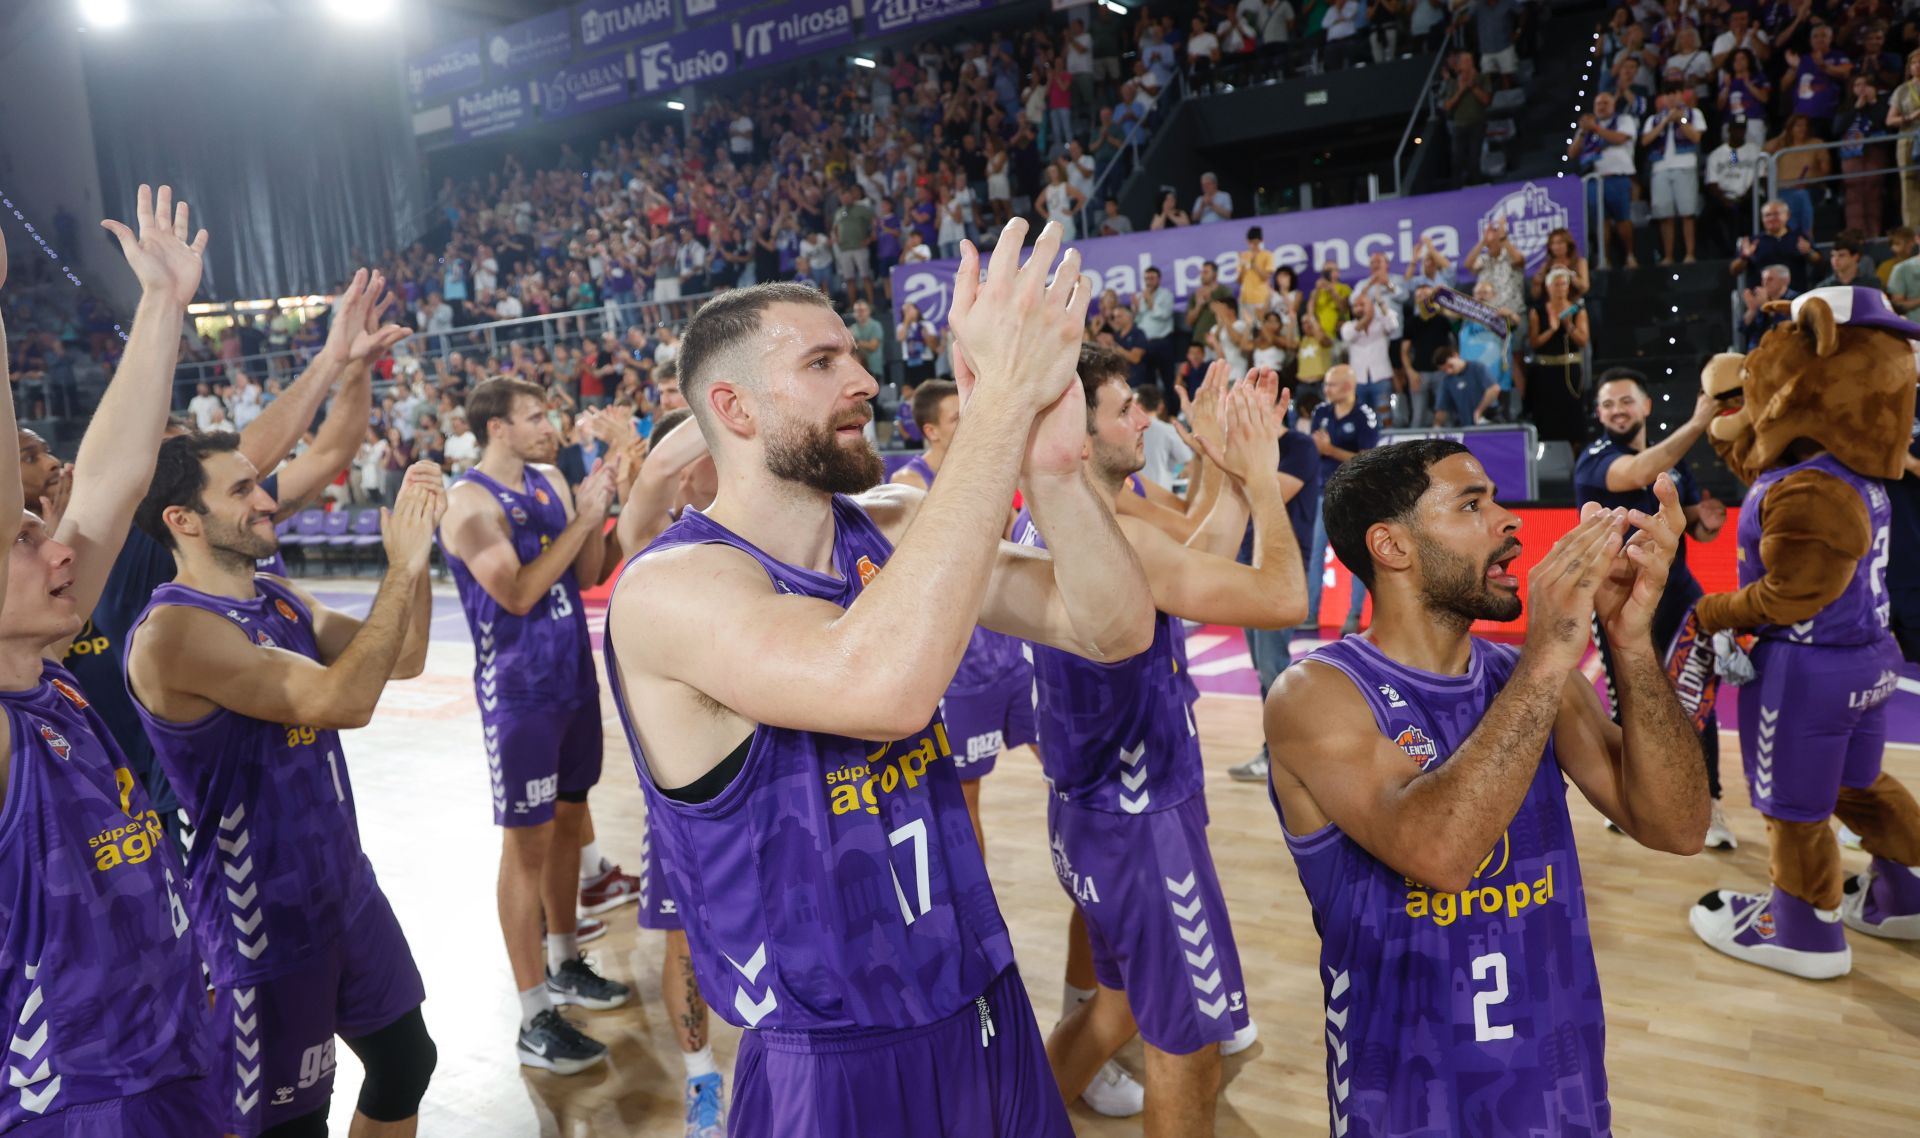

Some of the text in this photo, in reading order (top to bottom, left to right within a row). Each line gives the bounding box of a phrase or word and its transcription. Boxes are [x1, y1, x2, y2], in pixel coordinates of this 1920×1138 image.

[779, 5, 848, 41] nirosa
[1173, 219, 1460, 296] paencia
[1401, 743, 1434, 756] LENCIA
[1405, 864, 1554, 926] agropal
[1472, 952, 1514, 1042] 2
